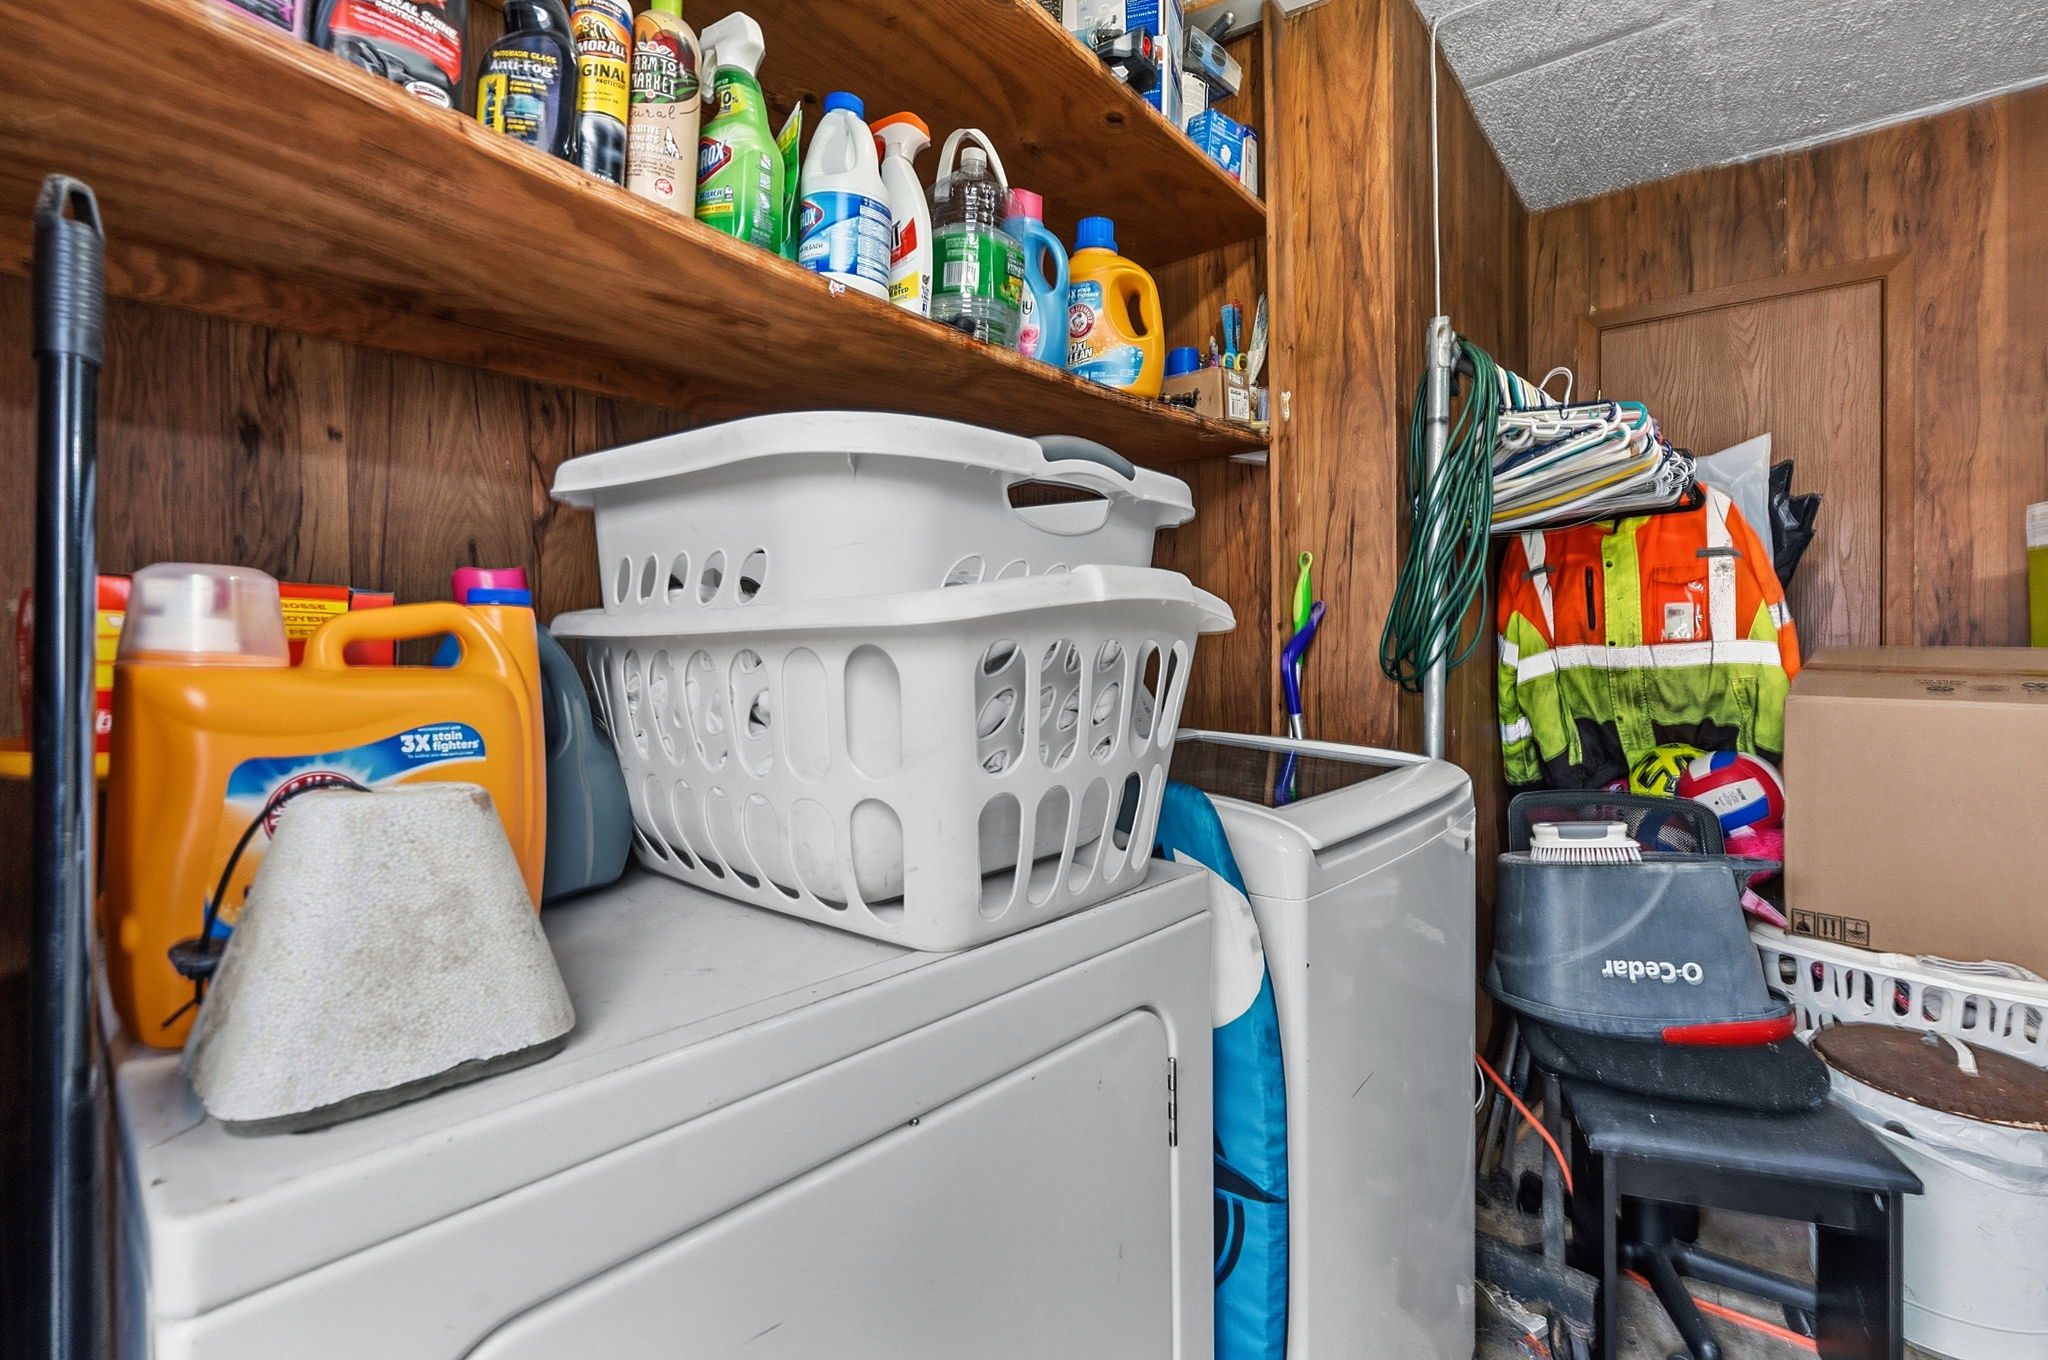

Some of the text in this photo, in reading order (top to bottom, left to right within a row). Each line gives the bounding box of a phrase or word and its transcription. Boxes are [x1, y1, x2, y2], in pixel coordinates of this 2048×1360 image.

[490, 60, 555, 79] Anti-Fog
[582, 63, 626, 84] GINAL
[660, 59, 677, 78] TO
[401, 730, 463, 753] 3X stain
[1601, 959, 1704, 986] O-Cedar
